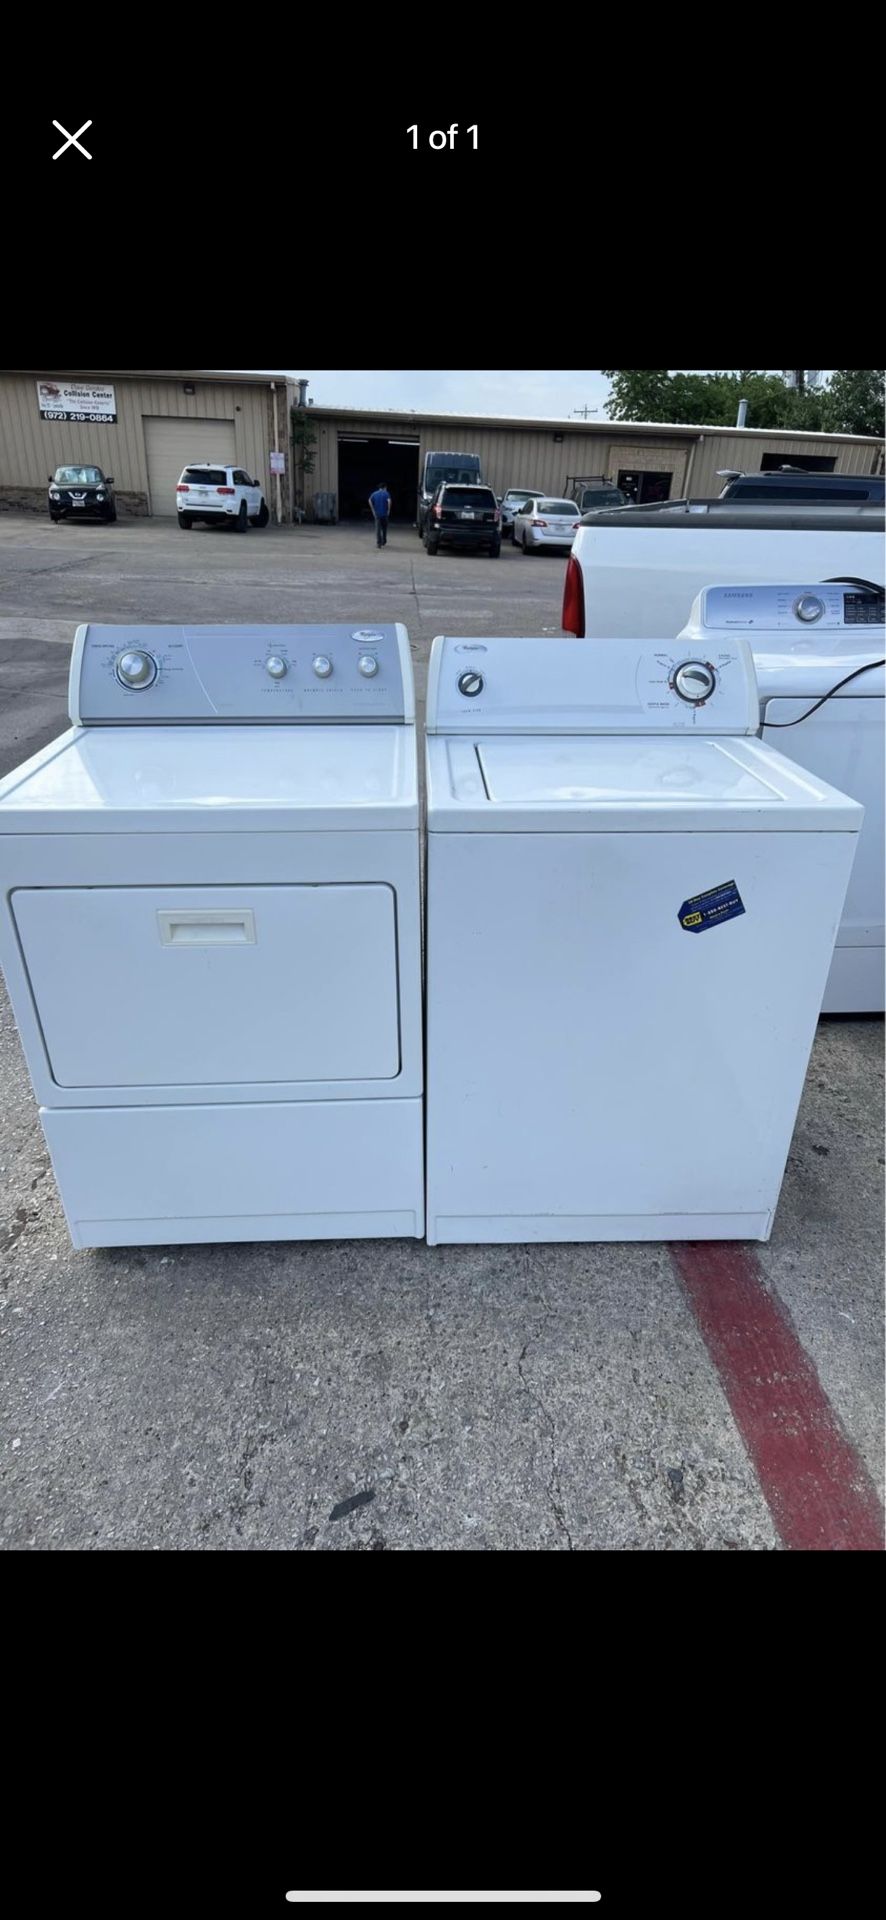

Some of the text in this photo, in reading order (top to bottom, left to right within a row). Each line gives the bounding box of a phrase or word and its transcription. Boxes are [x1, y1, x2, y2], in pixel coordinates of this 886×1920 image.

[63, 390, 112, 399] Collision Center
[44, 411, 67, 420] (972)
